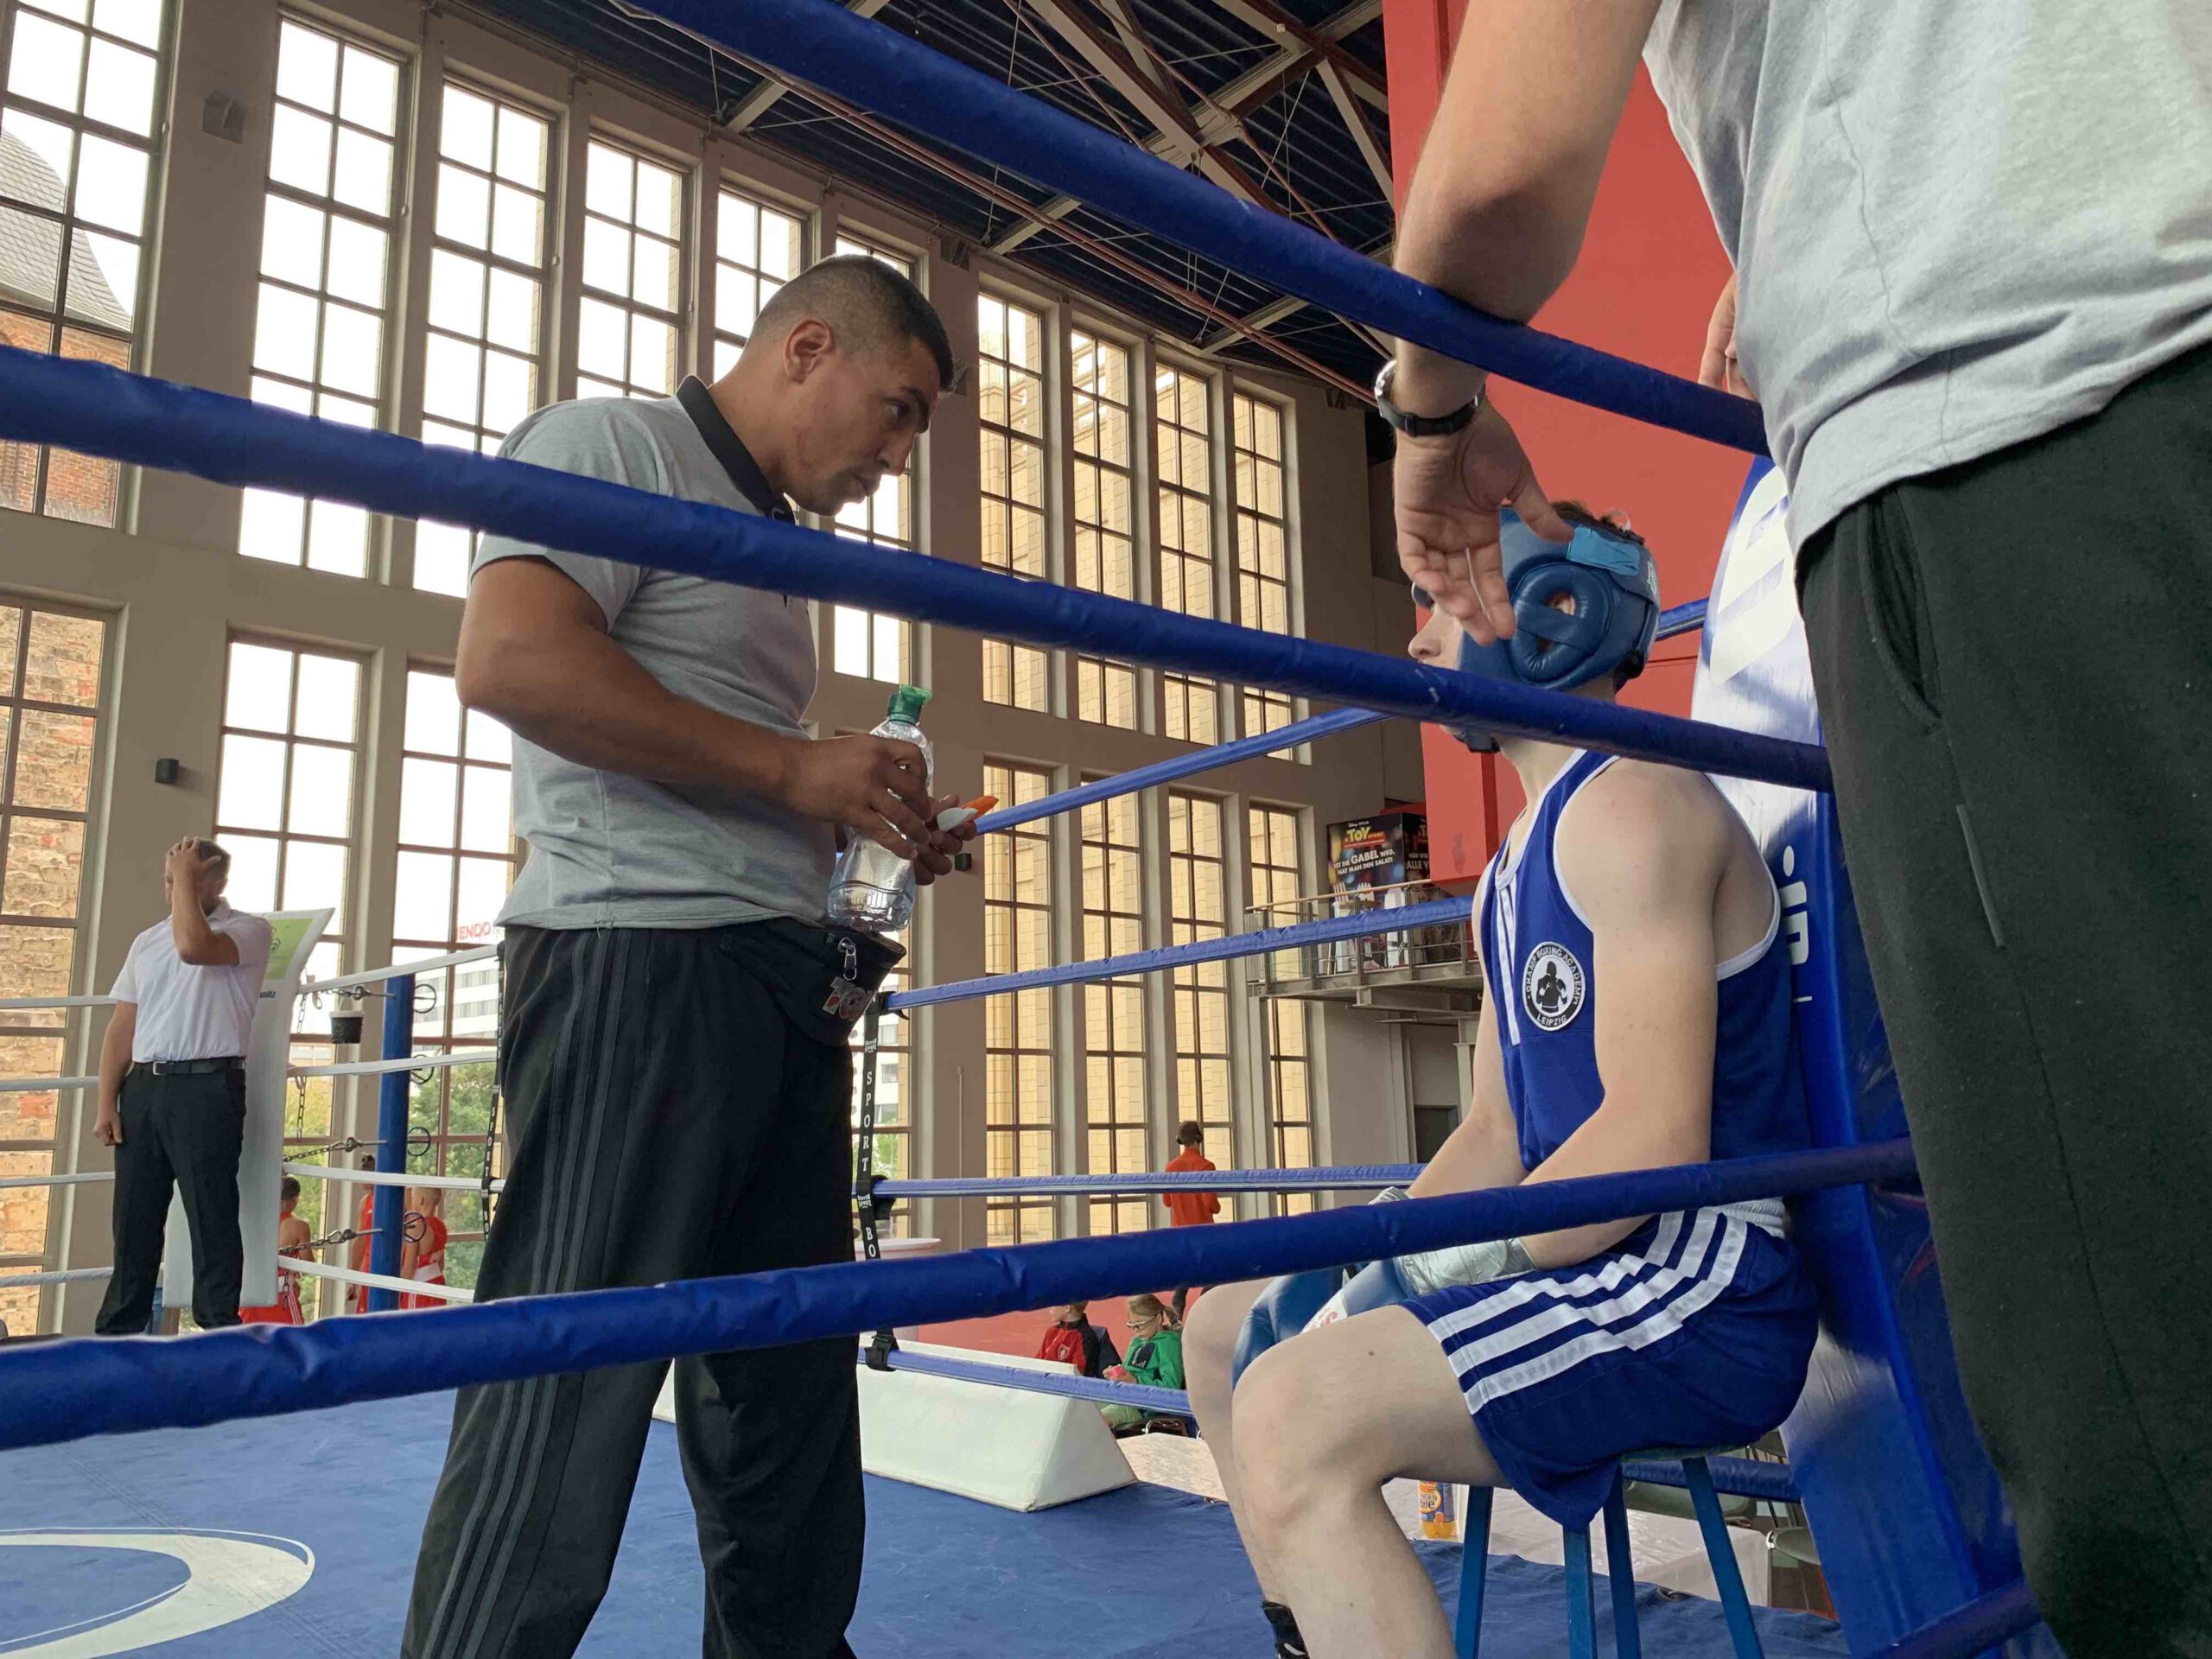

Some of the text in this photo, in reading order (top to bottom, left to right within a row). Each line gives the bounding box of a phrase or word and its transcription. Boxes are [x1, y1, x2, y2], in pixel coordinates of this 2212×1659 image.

[1351, 850, 1379, 864] GABEL
[1349, 864, 1363, 873] MAN
[1406, 861, 1422, 870] ALLE
[1536, 946, 1562, 957] BOXING
[1562, 954, 1582, 1005] ACADEMY
[1536, 1014, 1567, 1027] LEIPZIG
